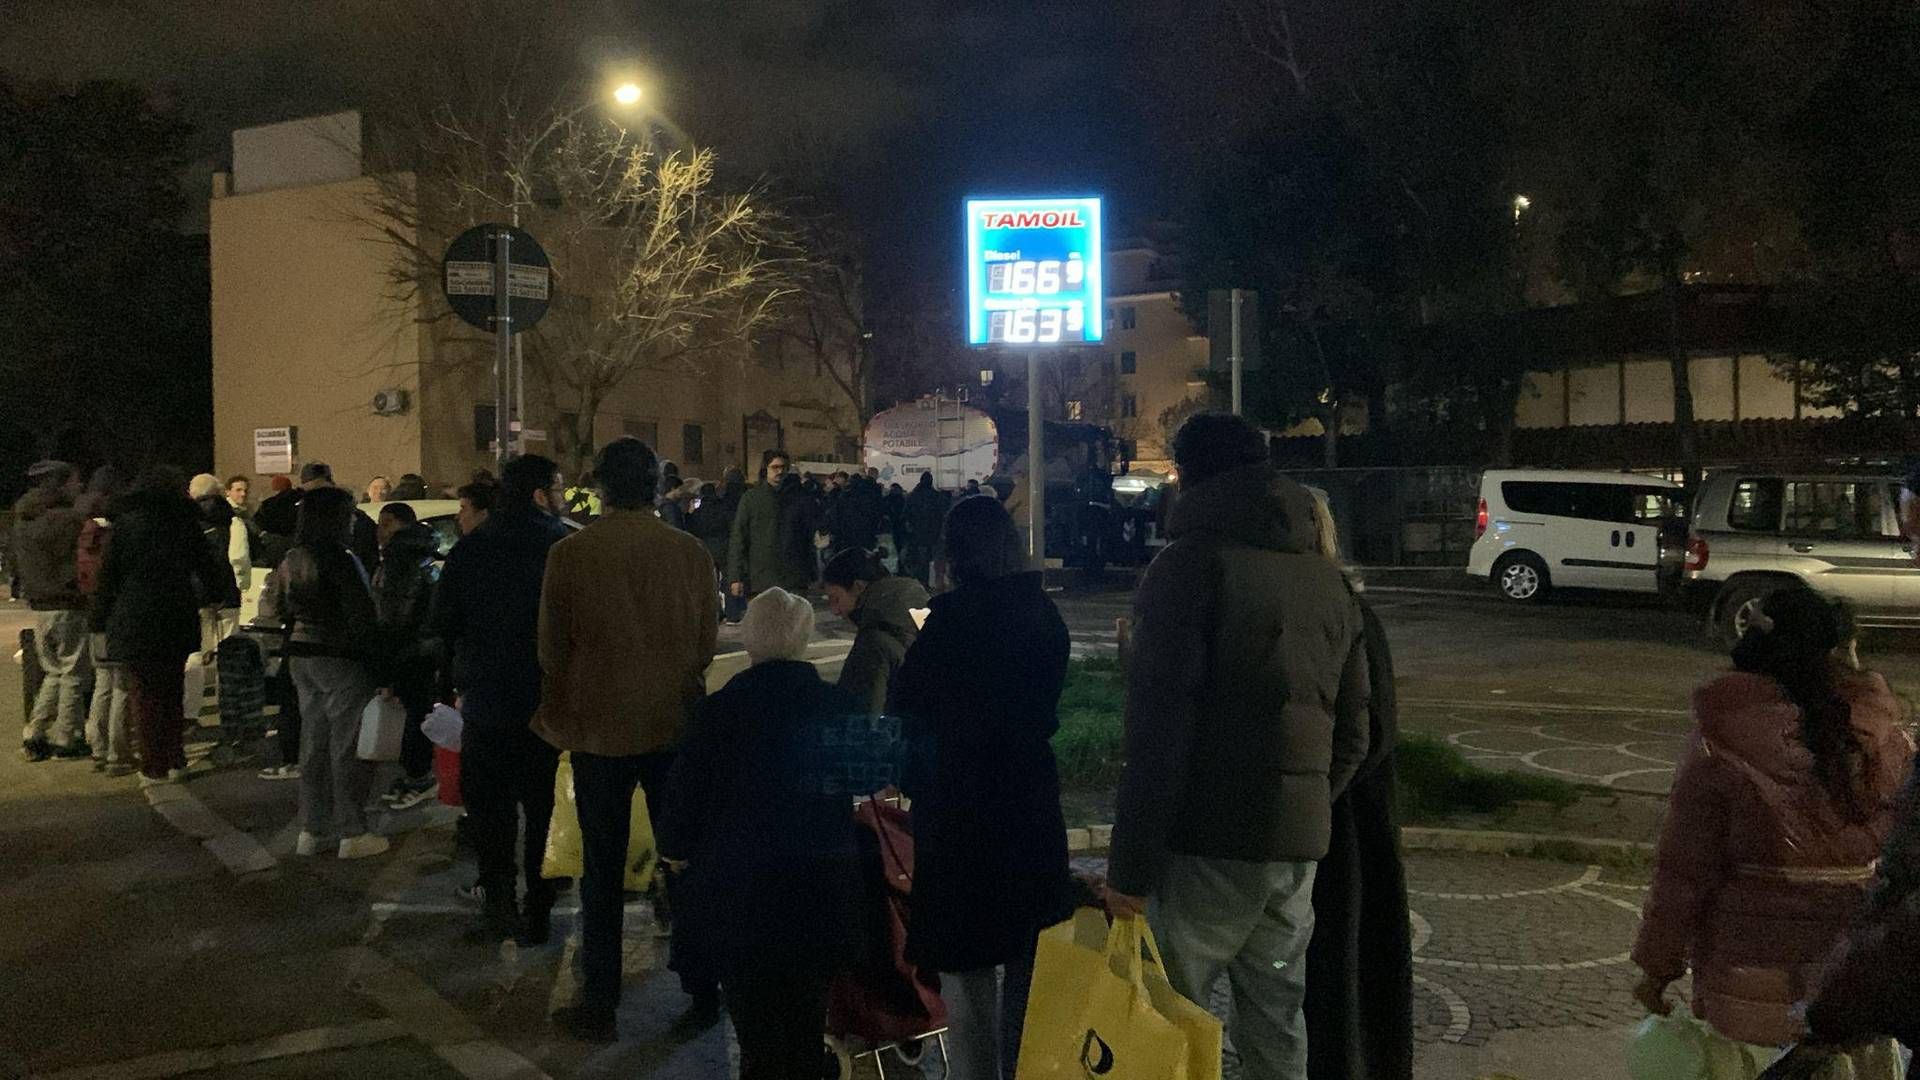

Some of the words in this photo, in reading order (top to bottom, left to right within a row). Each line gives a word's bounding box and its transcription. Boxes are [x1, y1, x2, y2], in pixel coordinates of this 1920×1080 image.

[984, 212, 1083, 228] TAMOIL
[984, 250, 1020, 261] Diesel
[882, 439, 924, 447] POTABILE
